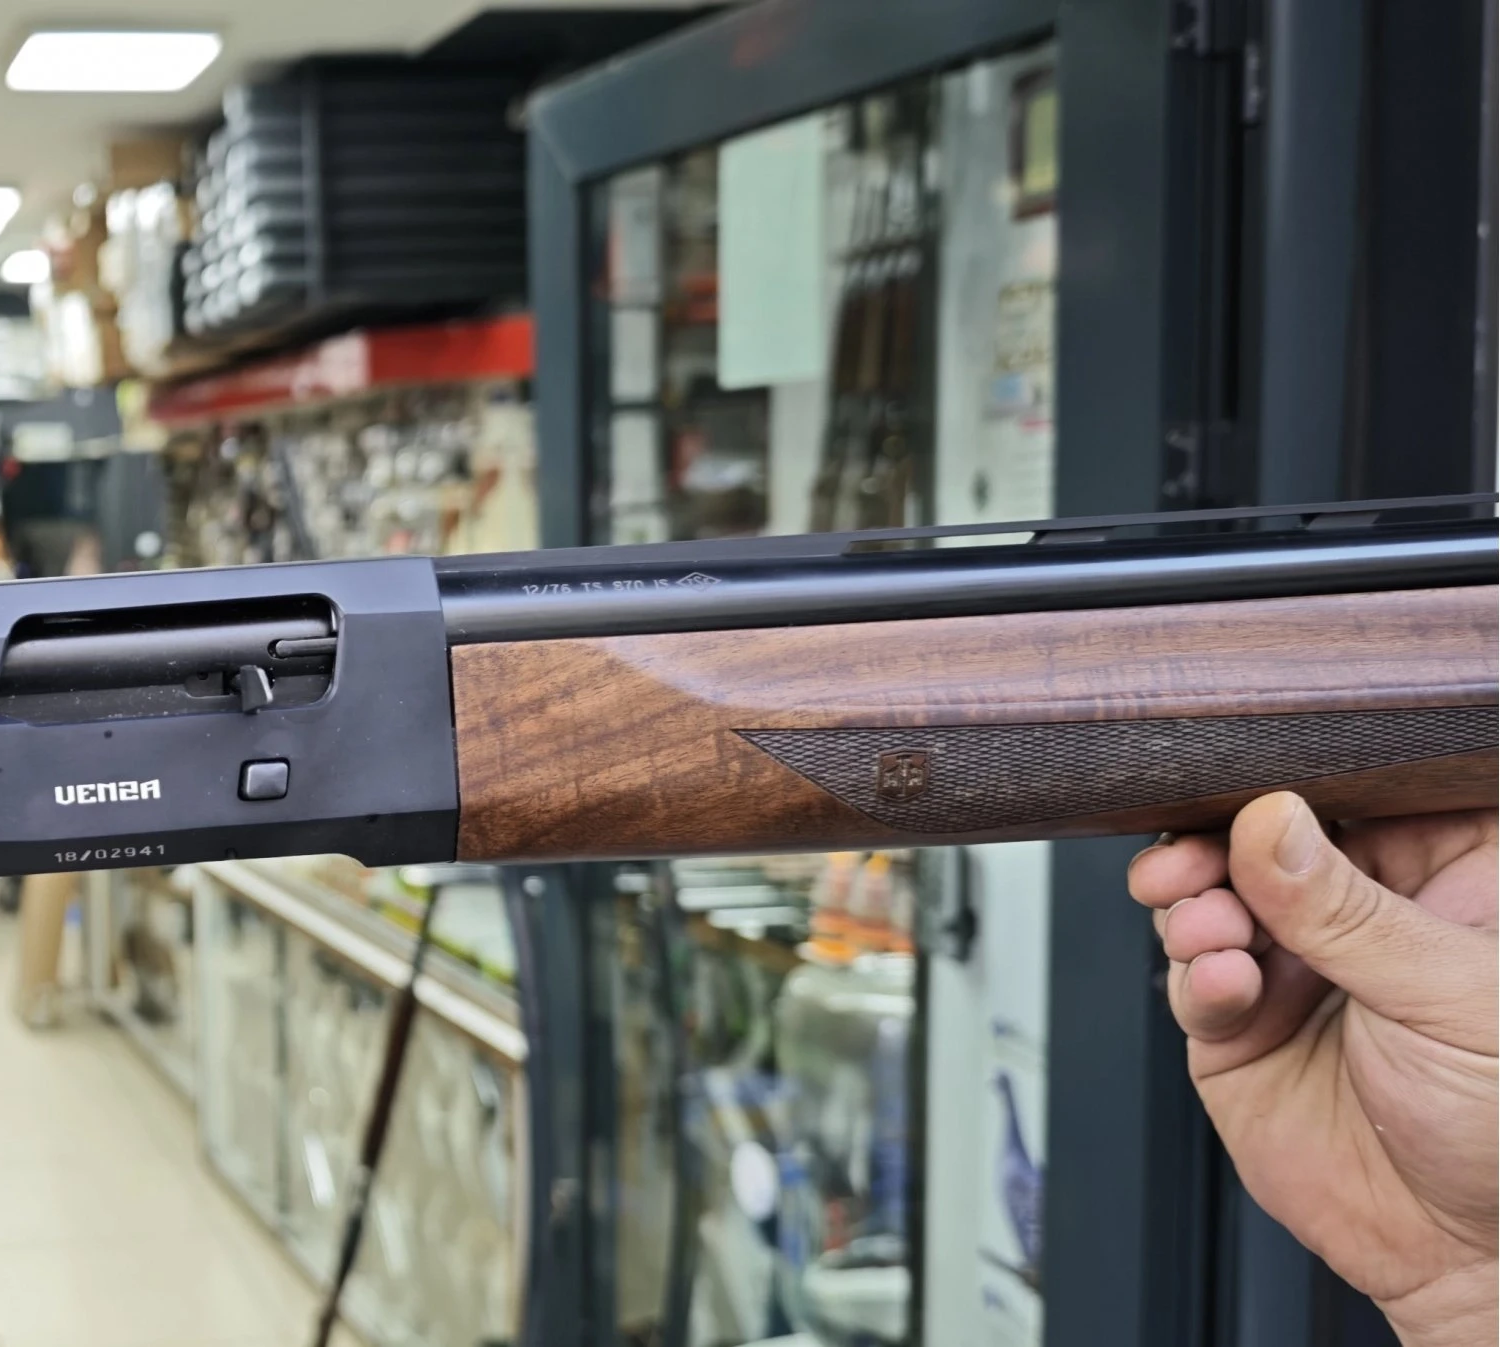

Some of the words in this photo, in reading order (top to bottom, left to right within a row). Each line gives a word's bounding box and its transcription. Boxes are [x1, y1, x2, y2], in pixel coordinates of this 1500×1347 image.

[522, 583, 572, 596] 12/76
[580, 581, 603, 593] TS
[54, 779, 161, 806] VENZA
[54, 845, 165, 863] 18/02941
